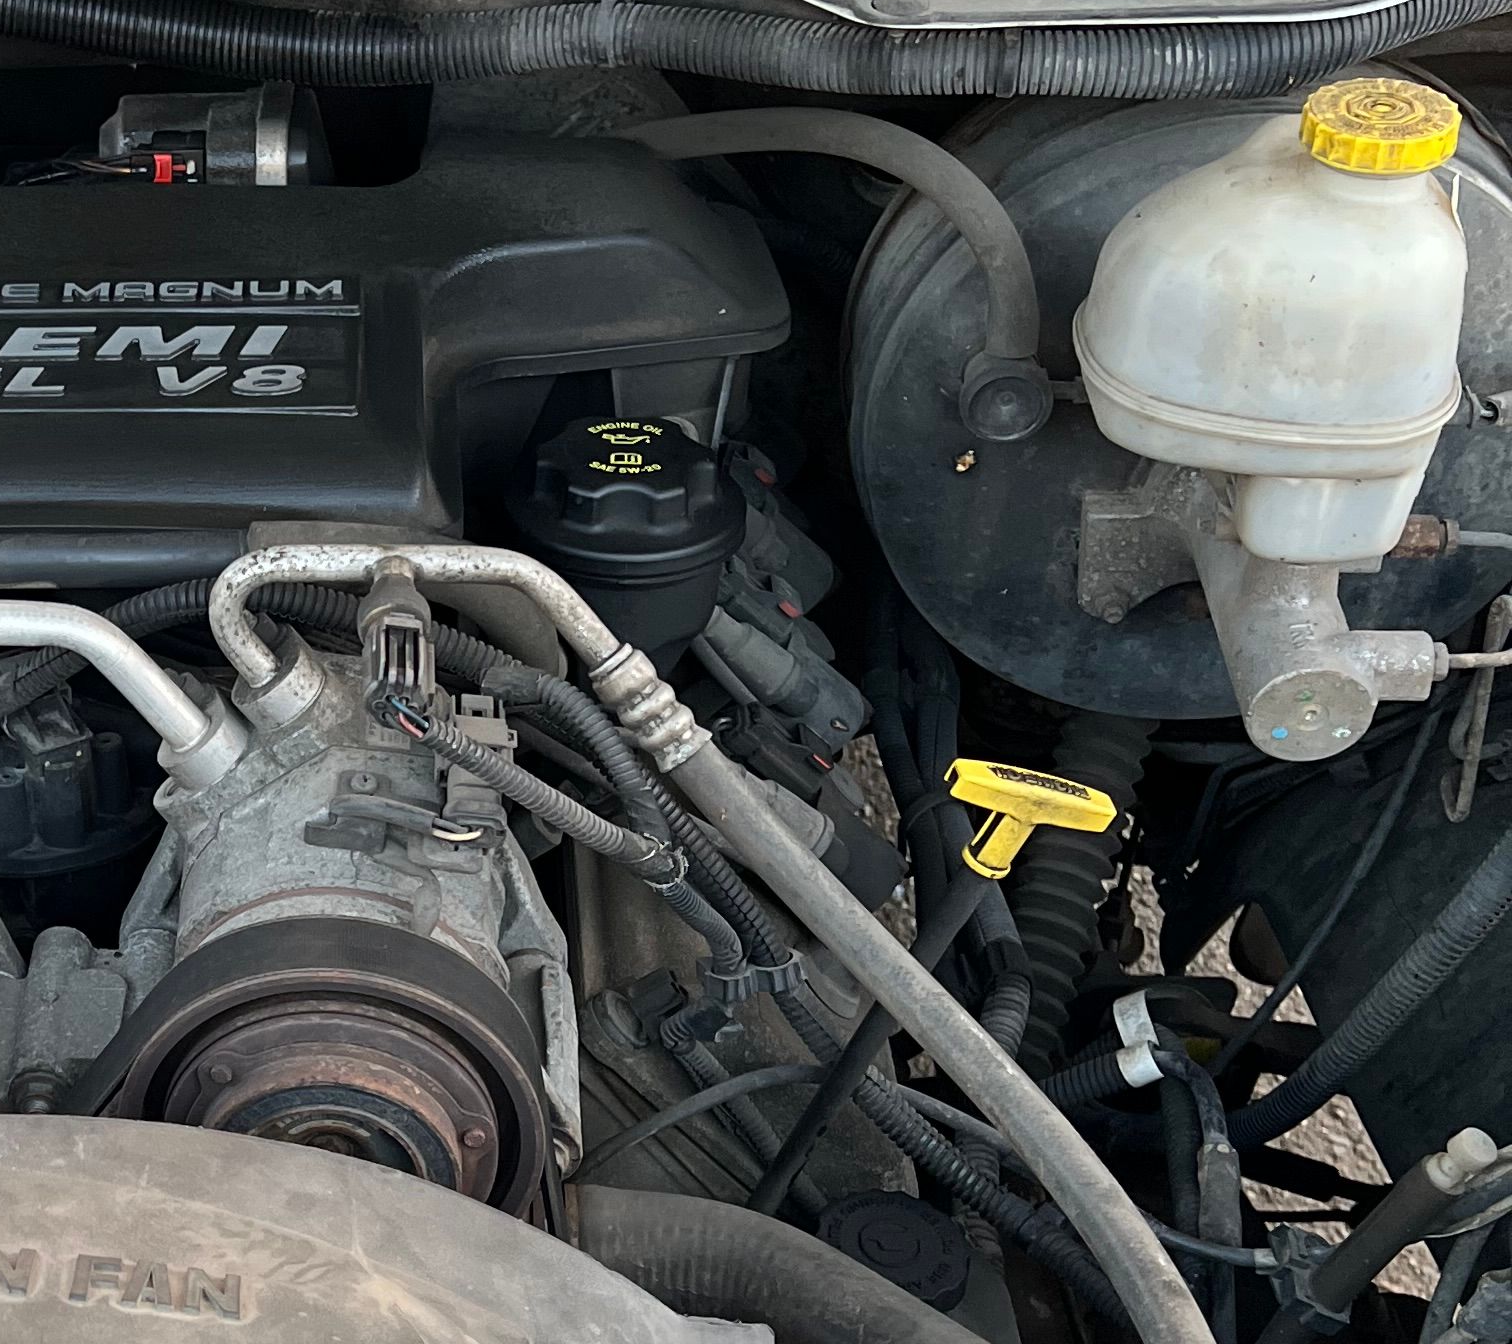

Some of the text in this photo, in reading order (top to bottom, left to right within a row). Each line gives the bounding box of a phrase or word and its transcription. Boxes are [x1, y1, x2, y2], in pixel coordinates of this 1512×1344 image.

[62, 279, 345, 304] MAGNUM
[158, 365, 308, 398] V8
[587, 421, 664, 436] ENGINE OIL
[589, 461, 617, 473] SAE
[68, 1253, 244, 1321] FAN
